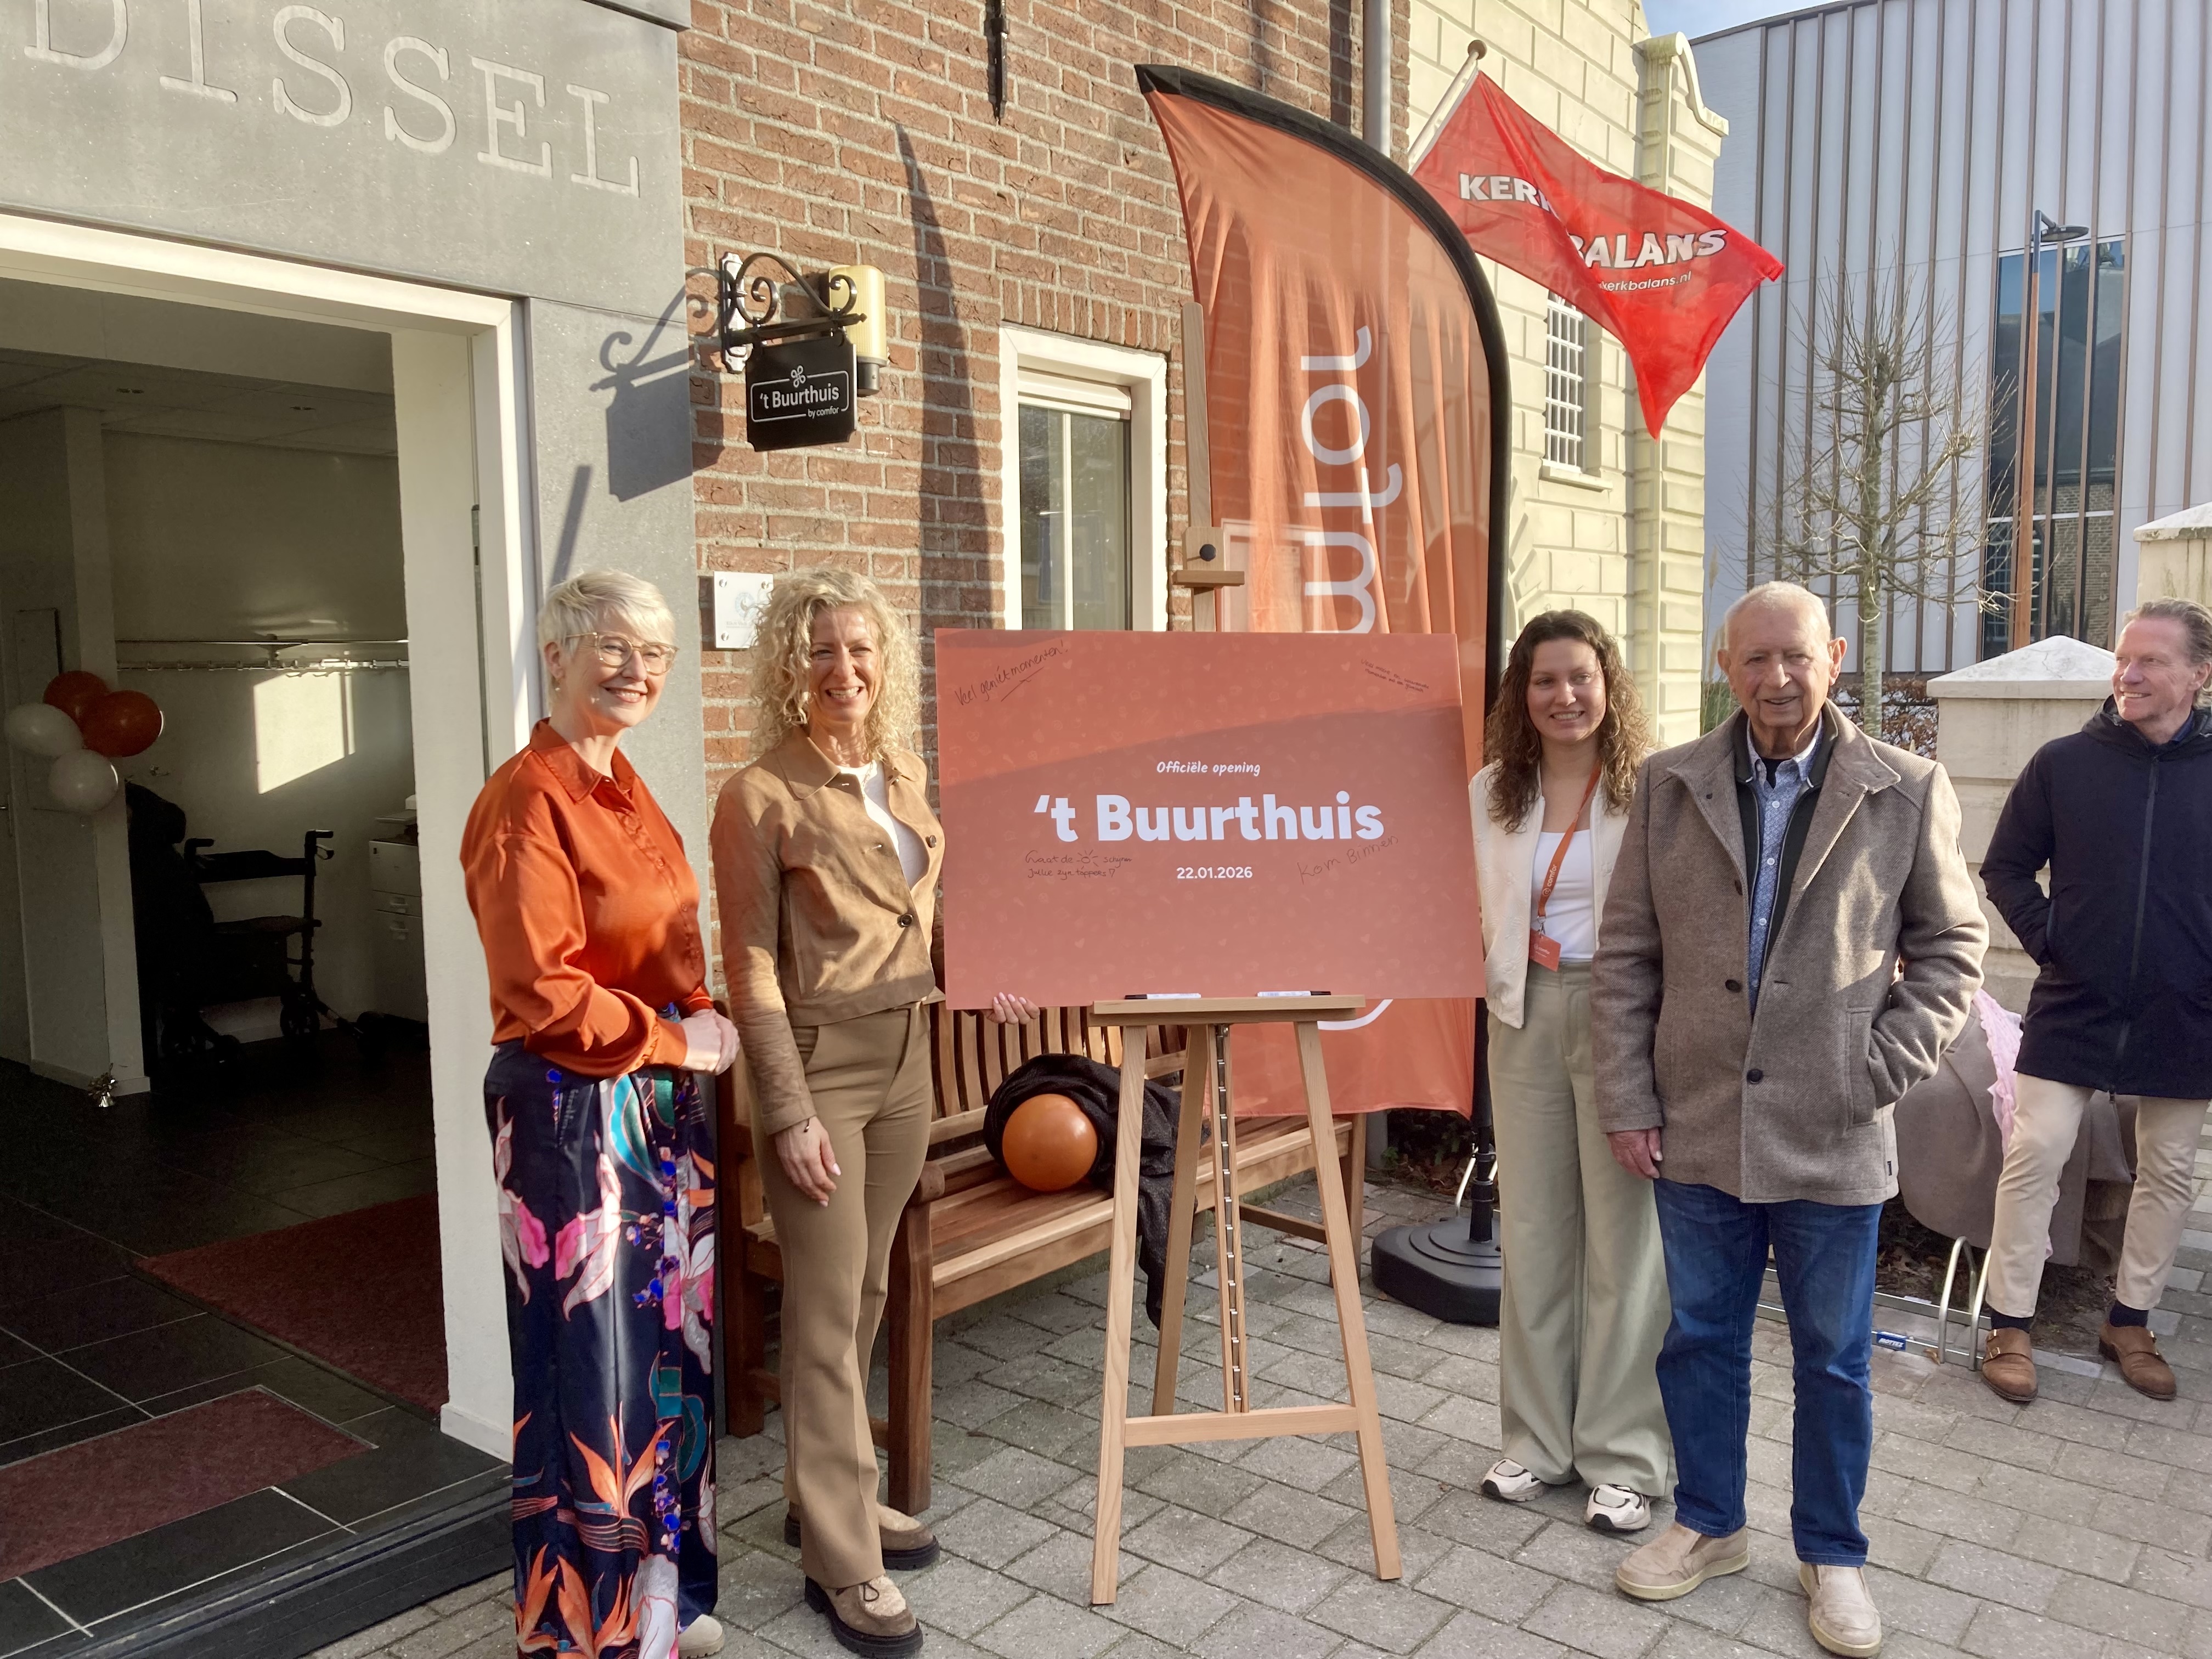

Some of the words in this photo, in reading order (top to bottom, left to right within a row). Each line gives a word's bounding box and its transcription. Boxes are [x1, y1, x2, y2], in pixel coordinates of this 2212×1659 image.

[24, 0, 641, 198] DISSEL
[759, 393, 769, 409] 't
[772, 383, 840, 408] Buurthuis
[808, 408, 816, 419] by
[816, 405, 840, 417] comfor
[955, 684, 977, 706] Veel
[1156, 761, 1208, 774] Officiële
[1212, 763, 1260, 777] opening
[1034, 794, 1079, 842] 't
[1096, 790, 1385, 842] Buurthuis
[1061, 854, 1074, 864] de
[1296, 857, 1342, 885] Kom
[1346, 834, 1399, 865] Binnen
[1176, 866, 1253, 879] 22.01.2026
[1547, 864, 1558, 887] comfor
